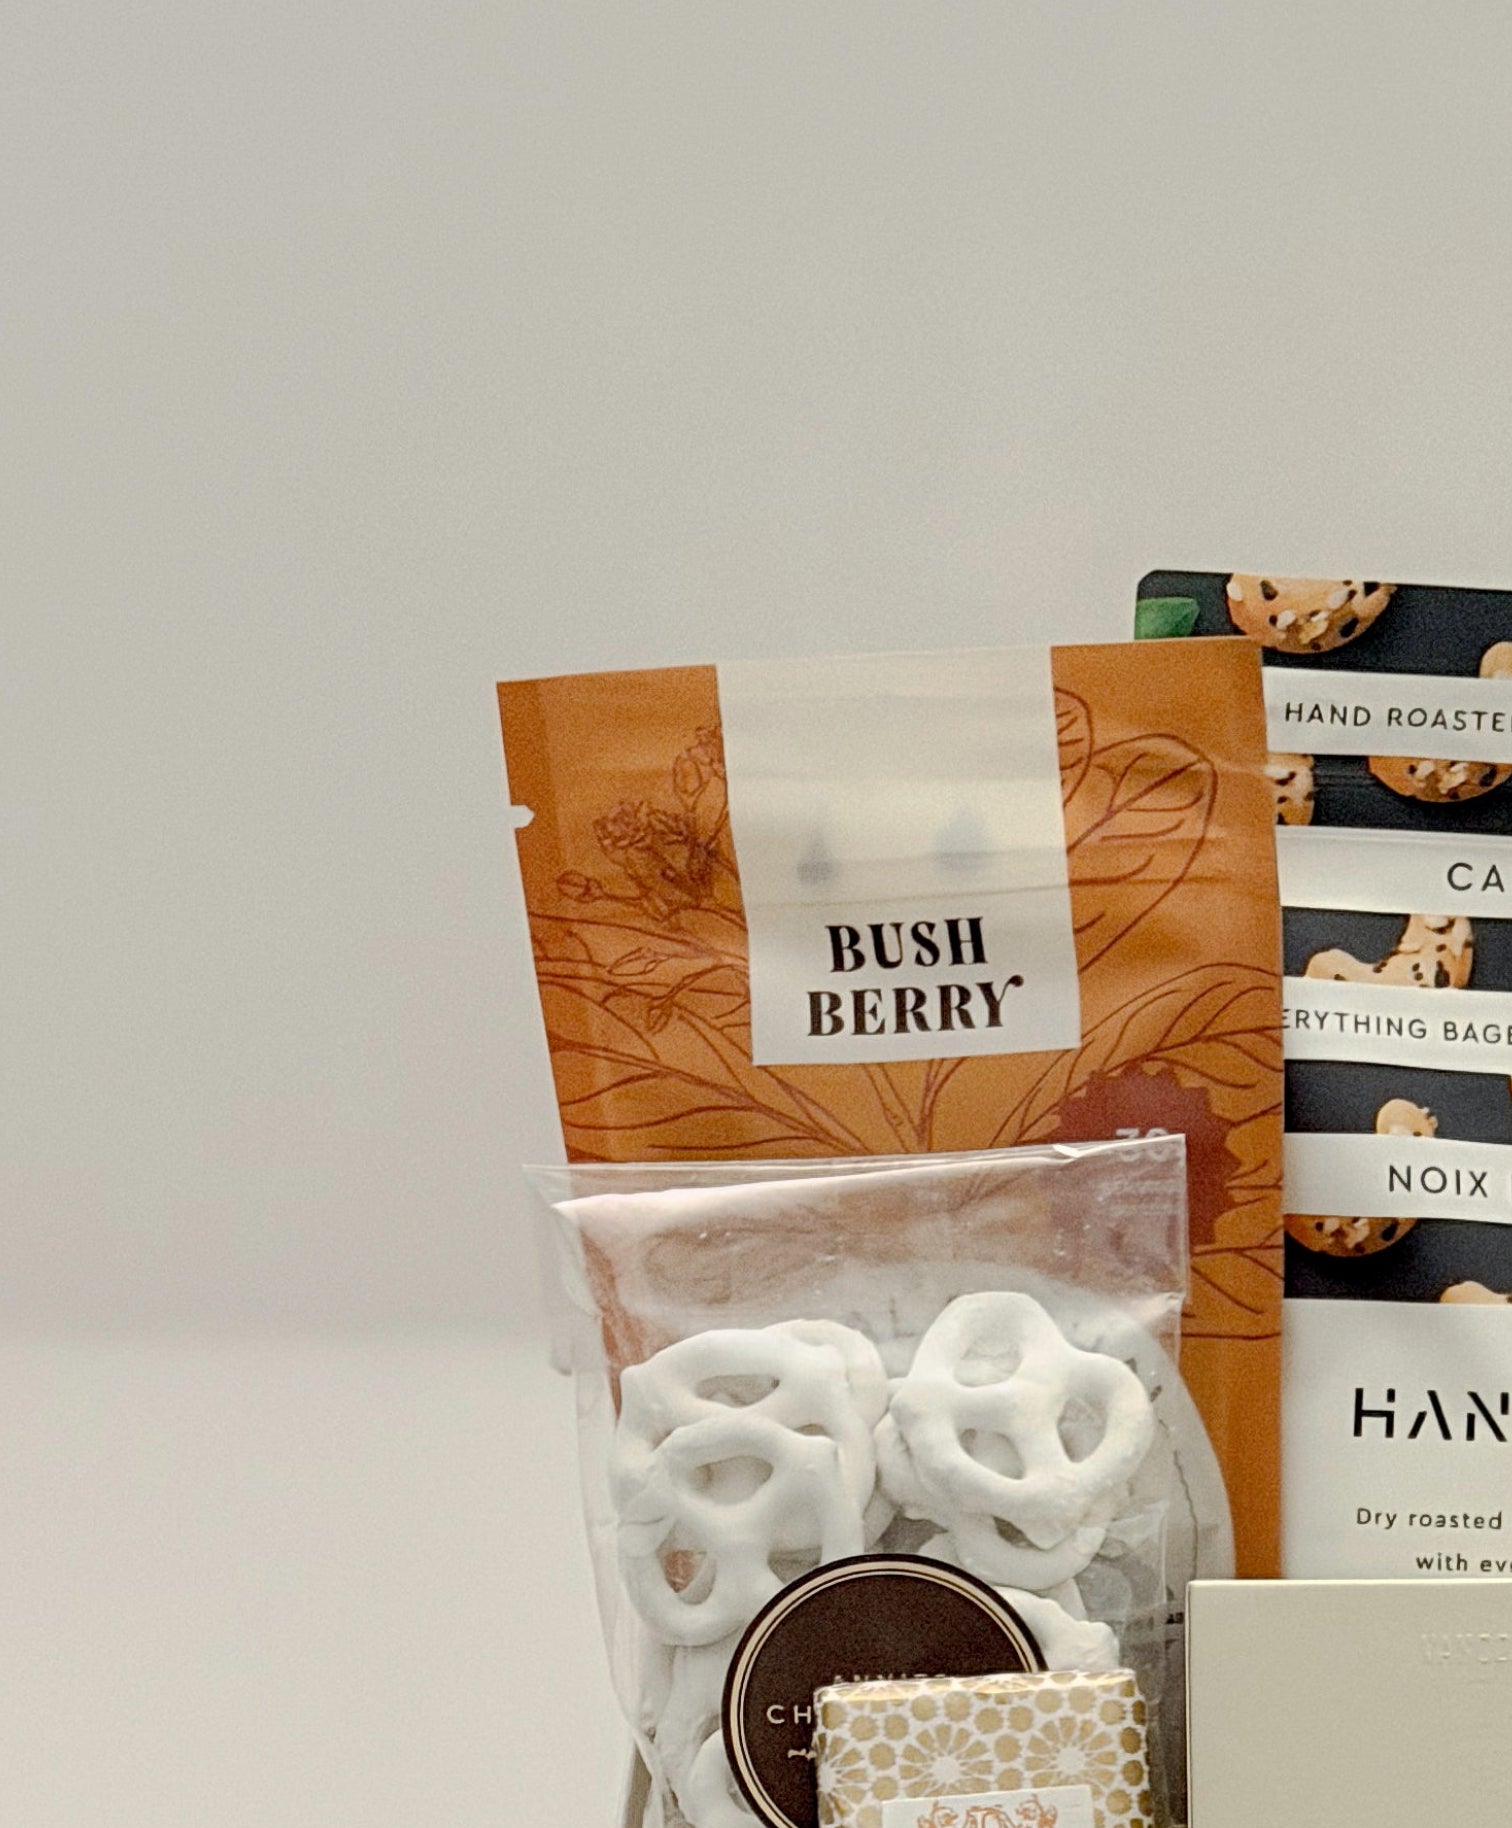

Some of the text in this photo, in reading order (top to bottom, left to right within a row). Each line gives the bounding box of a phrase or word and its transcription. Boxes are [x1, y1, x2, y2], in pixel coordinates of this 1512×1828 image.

[1284, 702, 1371, 727] HAND
[825, 916, 988, 973] BUSH
[807, 974, 1024, 1037] BERRY
[1388, 1164, 1488, 1198] NOIX
[1356, 1507, 1397, 1530] Dry
[1408, 1511, 1502, 1530] roasted
[1415, 1552, 1468, 1572] with
